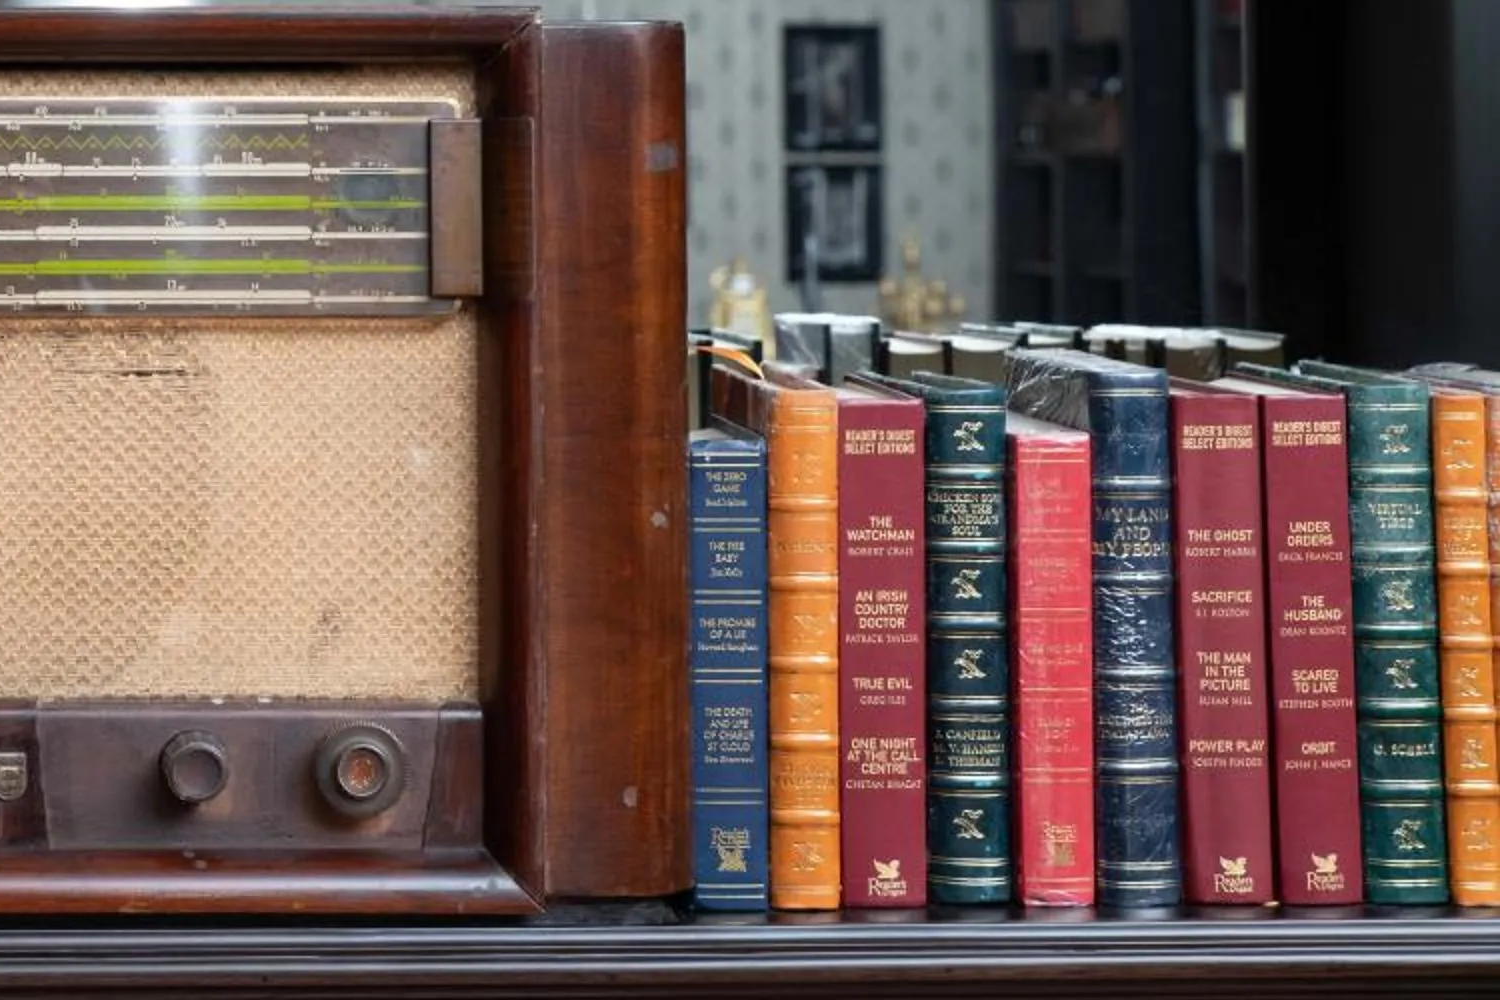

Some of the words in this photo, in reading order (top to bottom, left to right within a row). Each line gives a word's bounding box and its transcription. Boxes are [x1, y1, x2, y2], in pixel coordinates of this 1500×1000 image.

[1184, 425, 1223, 437] READER'S
[1226, 425, 1252, 437] DIGEST
[1274, 421, 1312, 433] READER'S
[1314, 421, 1341, 433] DIGEST
[846, 430, 885, 441] READER'S
[887, 430, 915, 441] DIGEST
[1273, 434, 1302, 446] SELECT
[1306, 434, 1341, 446] EDITIONS
[845, 443, 875, 454] SELECT
[878, 443, 915, 454] EDITIONS
[1183, 438, 1213, 449] SELECT
[1215, 438, 1252, 449] EDITIONS
[705, 472, 722, 482] THE
[713, 484, 740, 493] GAME
[944, 504, 968, 514] FOR
[971, 504, 992, 514] THE
[1129, 507, 1169, 521] LAND
[1368, 503, 1421, 515] VIRTUAL
[869, 516, 892, 527] THE
[952, 525, 982, 536] SOUL
[1116, 526, 1151, 540] AND
[1289, 522, 1330, 533] UNDER
[847, 530, 914, 541] WATCHMAN
[1188, 530, 1210, 541] THE
[1214, 530, 1252, 541] GHOST
[1288, 535, 1333, 546] ORDERS
[709, 541, 725, 551] THE
[1186, 548, 1220, 557] ROBERT
[1306, 552, 1342, 562] FRANCIS
[856, 591, 873, 601] AN
[876, 591, 907, 601] IRISH
[1192, 592, 1252, 603] SACRIFICE
[1302, 596, 1324, 607] THE
[855, 604, 909, 615] COUNTRY
[1284, 609, 1341, 620] HUSBAND
[700, 618, 717, 628] THE
[859, 617, 906, 628] DOCTOR
[710, 629, 724, 639] OF
[726, 629, 733, 639] A
[1197, 652, 1220, 663] THE
[1224, 652, 1251, 663] MAN
[1205, 666, 1220, 676] IN
[1224, 666, 1244, 676] THE
[1292, 669, 1338, 681] SCARED
[853, 678, 884, 689] TRUE
[887, 678, 912, 689] EVIL
[1200, 680, 1250, 691] PICTURE
[1294, 682, 1308, 693] TO
[1312, 682, 1337, 693] LIVE
[1233, 696, 1252, 705] HILL
[704, 708, 723, 717] THE
[724, 708, 752, 717] DEATH
[710, 719, 728, 729] AND
[731, 719, 749, 729] LIFE
[704, 730, 717, 740] OF
[946, 729, 1001, 740] CANFIELD
[707, 742, 717, 751] ST
[719, 742, 750, 751] CLOUD
[852, 738, 876, 750] ONE
[880, 738, 916, 750] NIGHT
[1190, 740, 1232, 752] POWER
[1236, 740, 1264, 752] PLAY
[1302, 742, 1335, 754] ORBIT
[847, 751, 862, 761] AT
[865, 751, 887, 761] THE
[891, 751, 920, 761] CALL
[862, 763, 908, 774] CENTRE
[1285, 760, 1311, 769] JOHN
[846, 780, 884, 789] CHETAN
